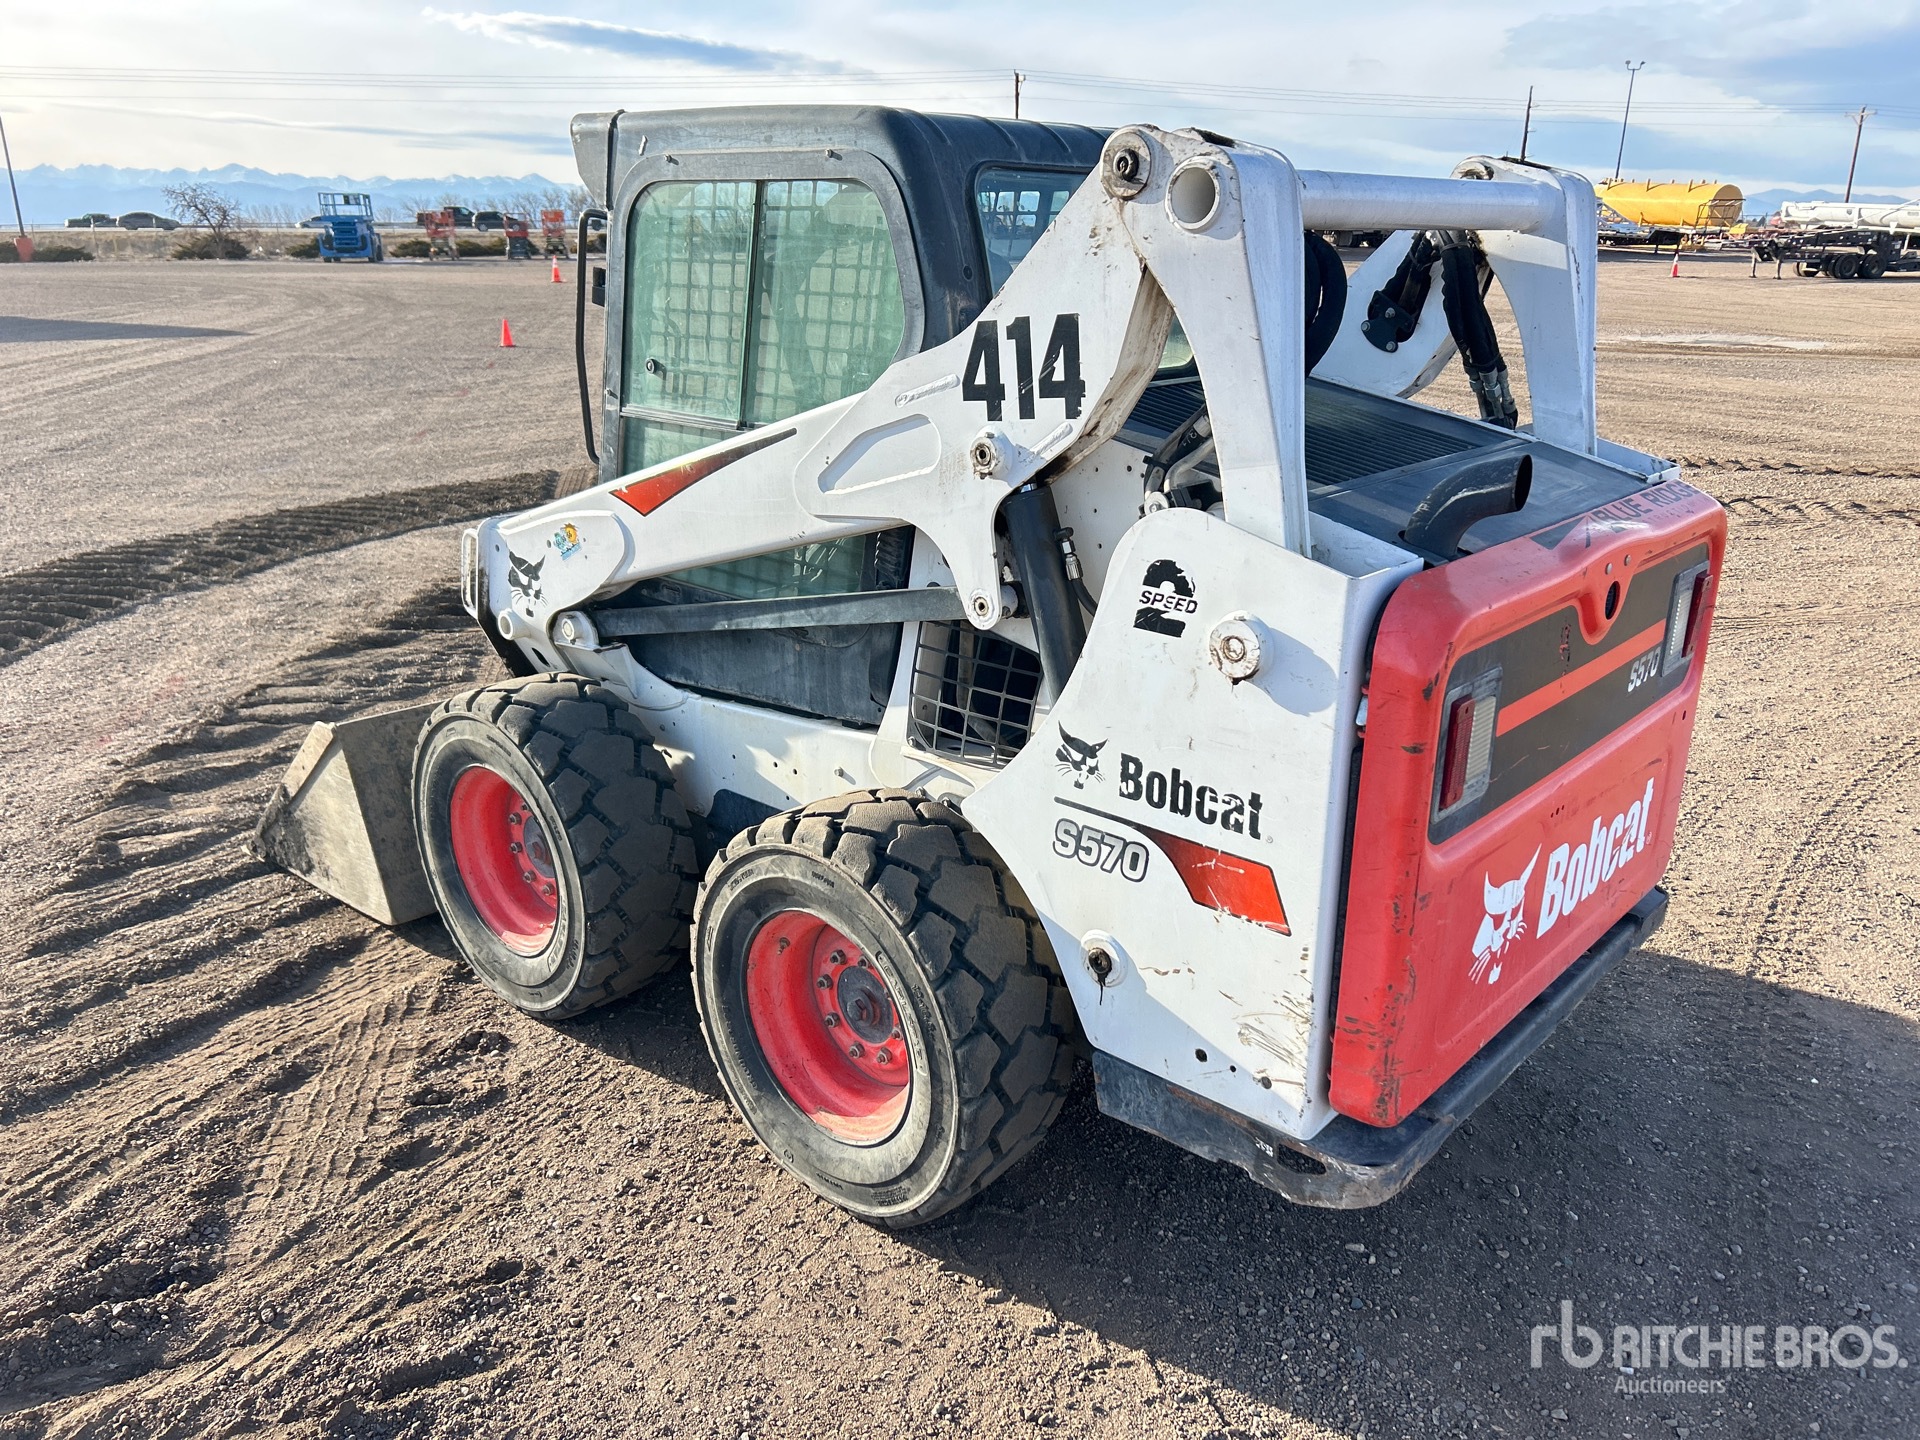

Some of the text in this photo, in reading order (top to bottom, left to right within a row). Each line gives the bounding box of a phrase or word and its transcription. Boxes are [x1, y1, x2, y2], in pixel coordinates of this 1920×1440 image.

[962, 313, 1086, 421] 414
[1592, 498, 1654, 521] BLUE
[1640, 480, 1701, 507] RIDGE
[1139, 590, 1198, 614] SPEED
[1628, 646, 1661, 692] S570
[1119, 752, 1264, 840] Bobcat
[1053, 818, 1149, 882] S570
[1537, 777, 1655, 939] Bobcat
